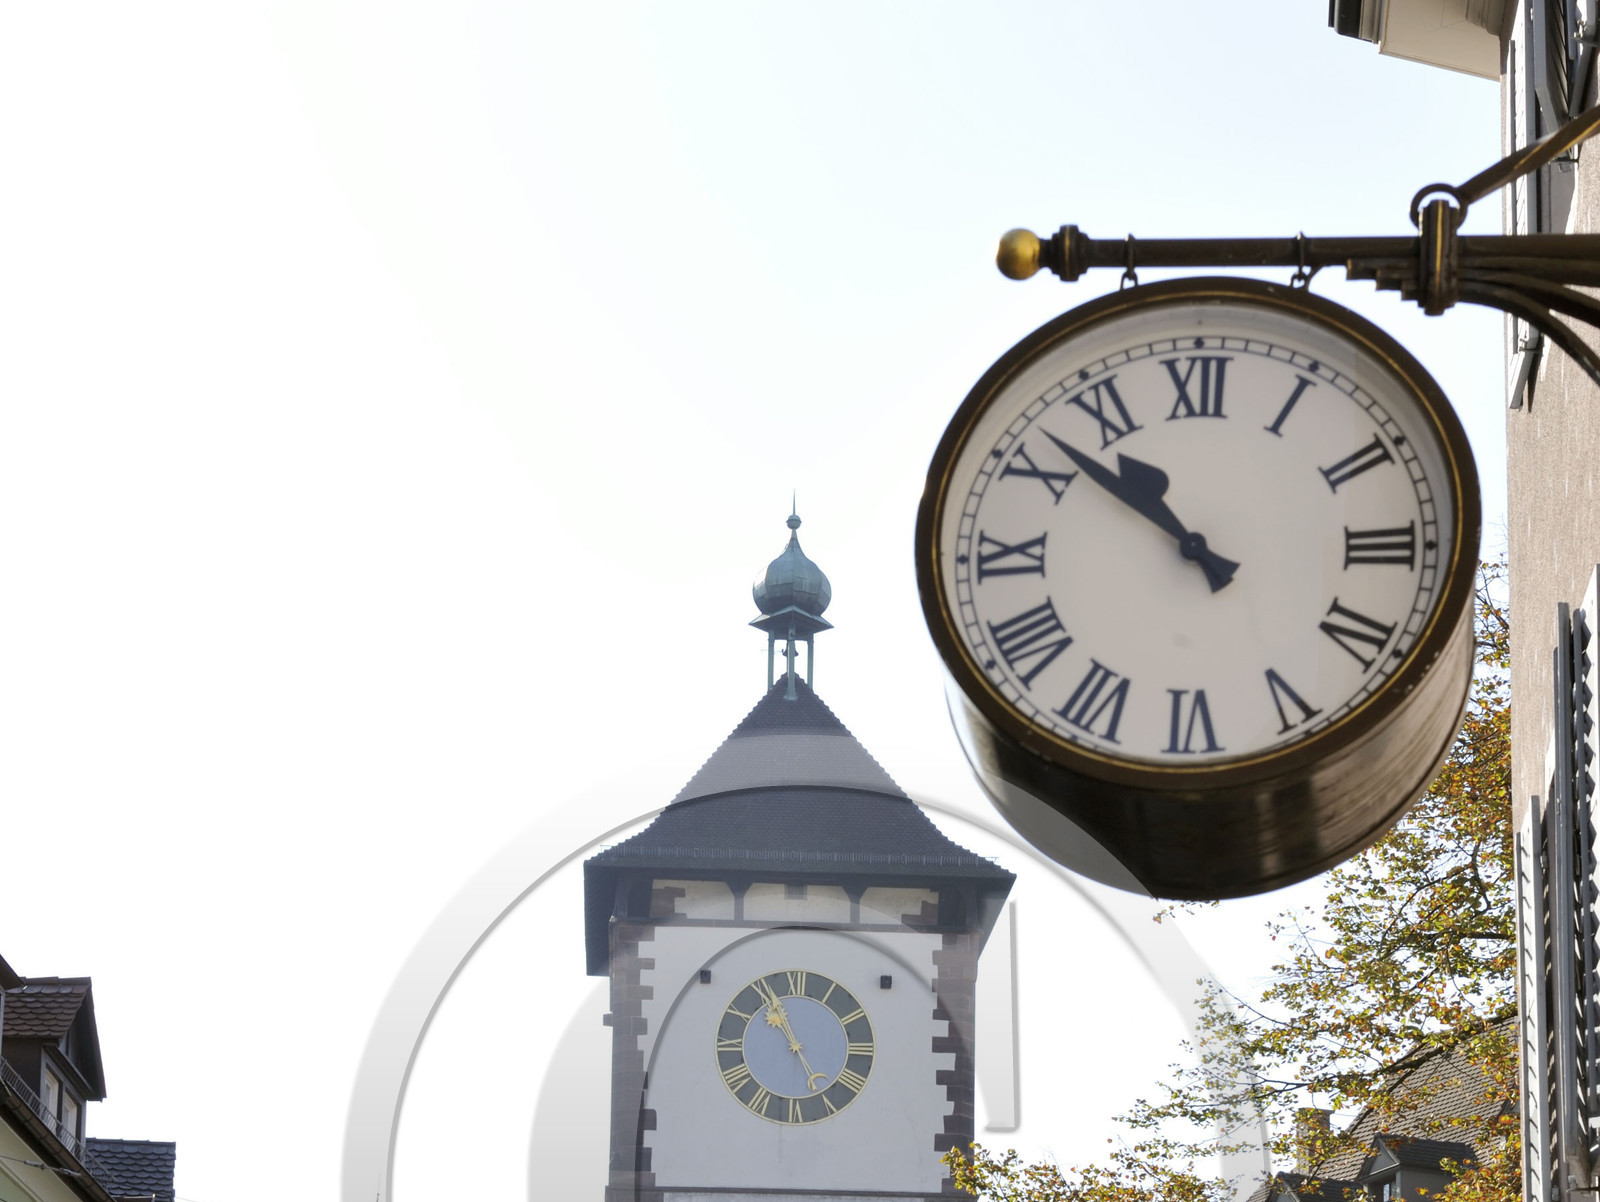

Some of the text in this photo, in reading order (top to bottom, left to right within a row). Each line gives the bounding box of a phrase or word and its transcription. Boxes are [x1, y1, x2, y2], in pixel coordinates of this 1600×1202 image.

[1065, 373, 1144, 451] XI
[1159, 356, 1234, 422] XII
[998, 441, 1079, 505] X
[1318, 432, 1396, 494] II
[976, 530, 1048, 585] IX
[1343, 519, 1416, 572] III
[986, 596, 1074, 692] VIII
[1052, 658, 1132, 745] VII
[1161, 688, 1225, 754] VI
[1264, 667, 1323, 736] V
